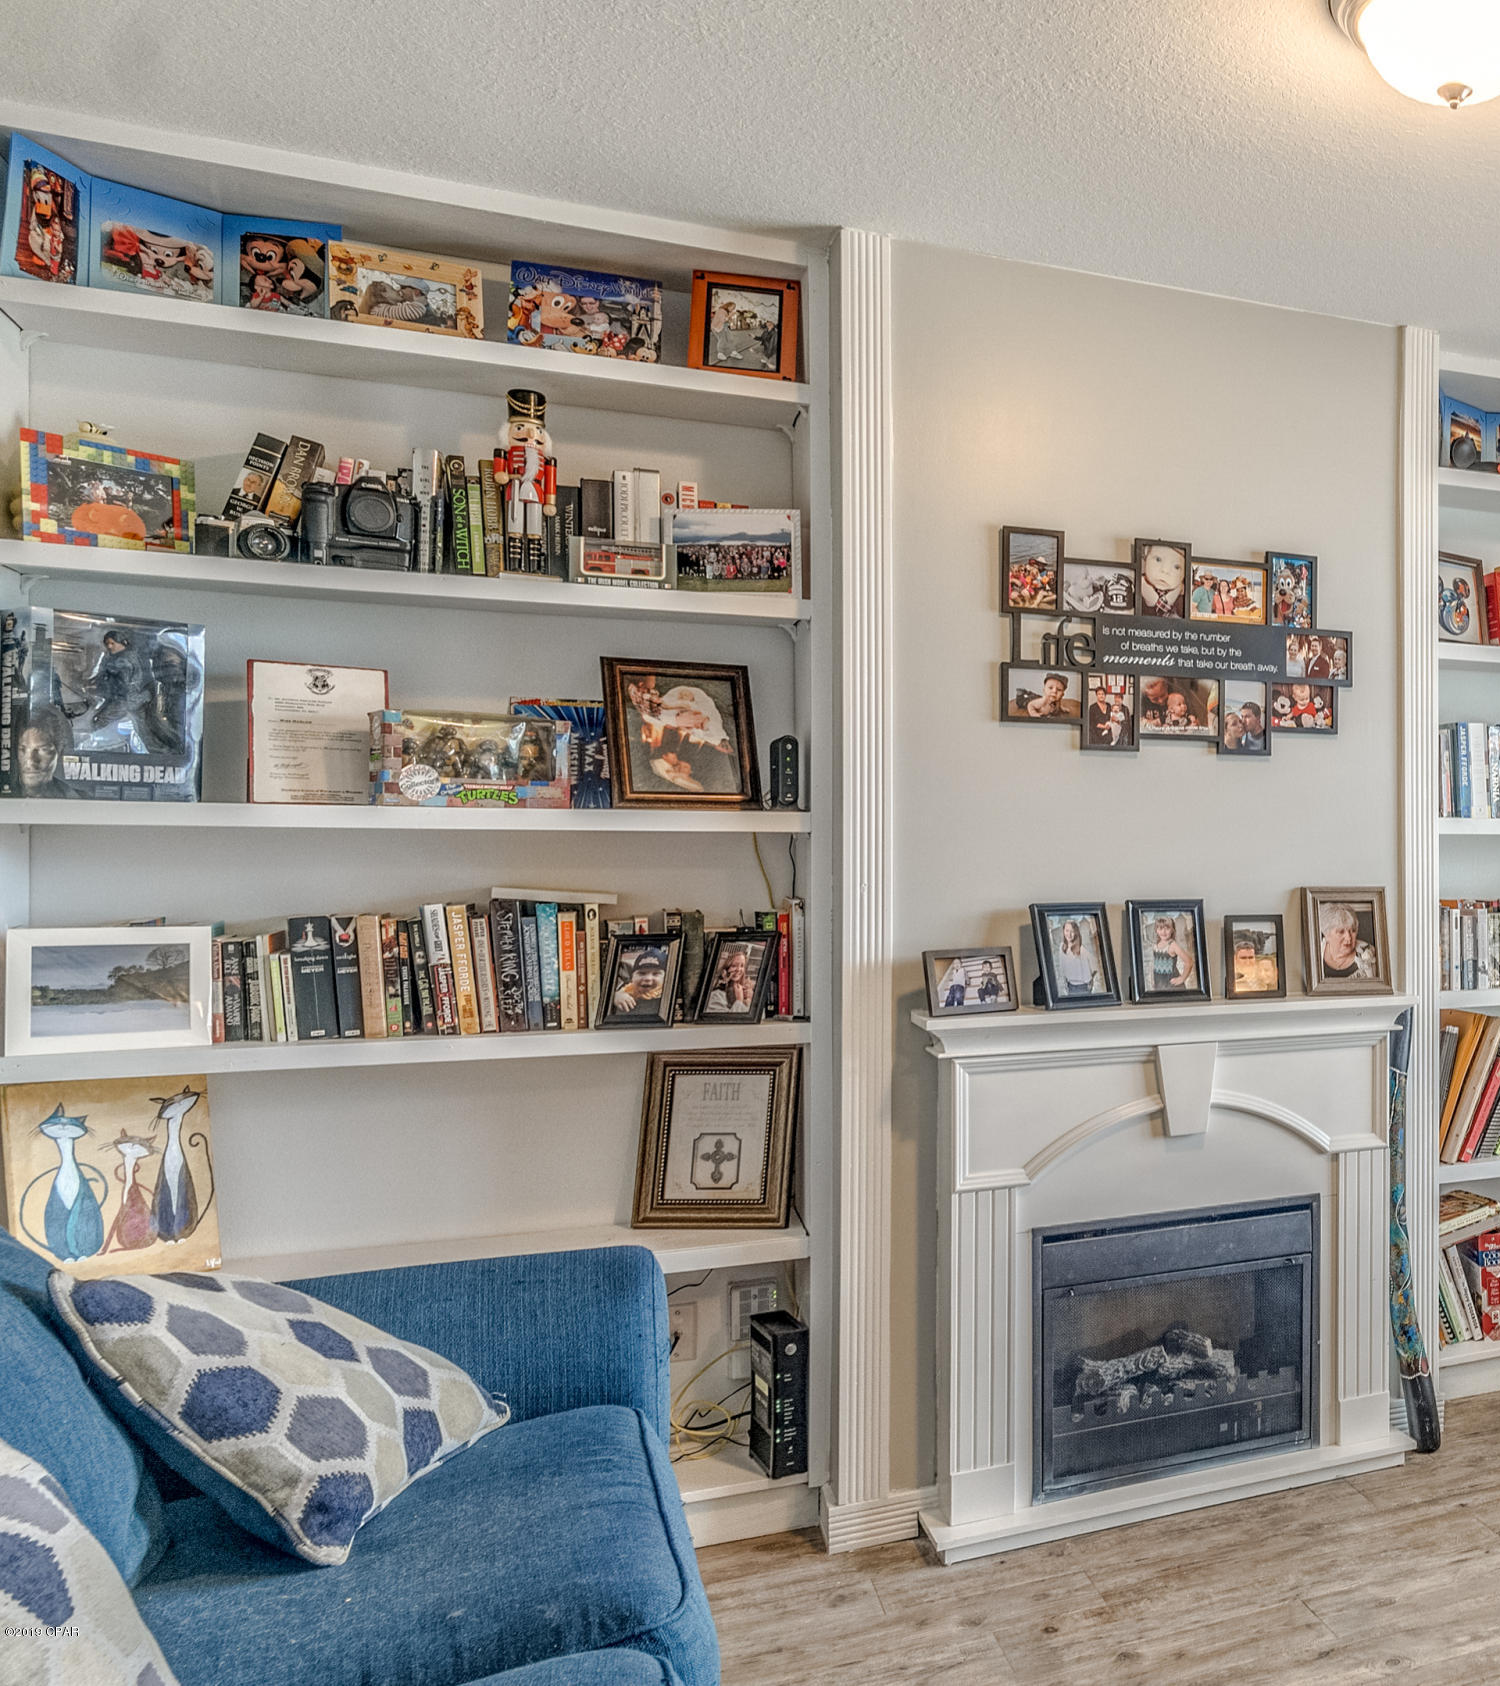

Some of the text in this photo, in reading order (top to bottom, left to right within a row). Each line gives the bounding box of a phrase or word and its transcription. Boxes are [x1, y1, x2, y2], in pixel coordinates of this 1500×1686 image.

[248, 455, 274, 469] DECISION
[249, 460, 270, 471] POINTS
[293, 440, 311, 469] DAN
[453, 488, 466, 516] SON
[456, 528, 470, 569] WITCH
[1111, 628, 1126, 637] not
[1127, 629, 1171, 640] measured
[1172, 631, 1183, 642] by
[1185, 632, 1198, 641] the
[1199, 633, 1231, 643] number
[1120, 641, 1130, 650] of
[1131, 642, 1164, 653] breaths
[1165, 645, 1178, 653] we
[1201, 647, 1215, 656] but
[1217, 648, 1227, 658] by
[1229, 648, 1242, 657] the
[1102, 653, 1278, 674] moments that take our breath away.
[1, 728, 11, 772] DEAD
[1460, 726, 1468, 755] JASPER
[583, 741, 598, 772] WAX
[63, 762, 187, 784] WALKING DEAD
[1491, 761, 1500, 802] NARNIA
[455, 788, 519, 805] TURTLES
[451, 912, 470, 992] JASPER FFORDE
[496, 910, 519, 982] STEPHEN KING
[563, 922, 573, 970] CLOUD ATLAS
[511, 986, 524, 1014] DOCTOR
[703, 1082, 741, 1101] FAITH
